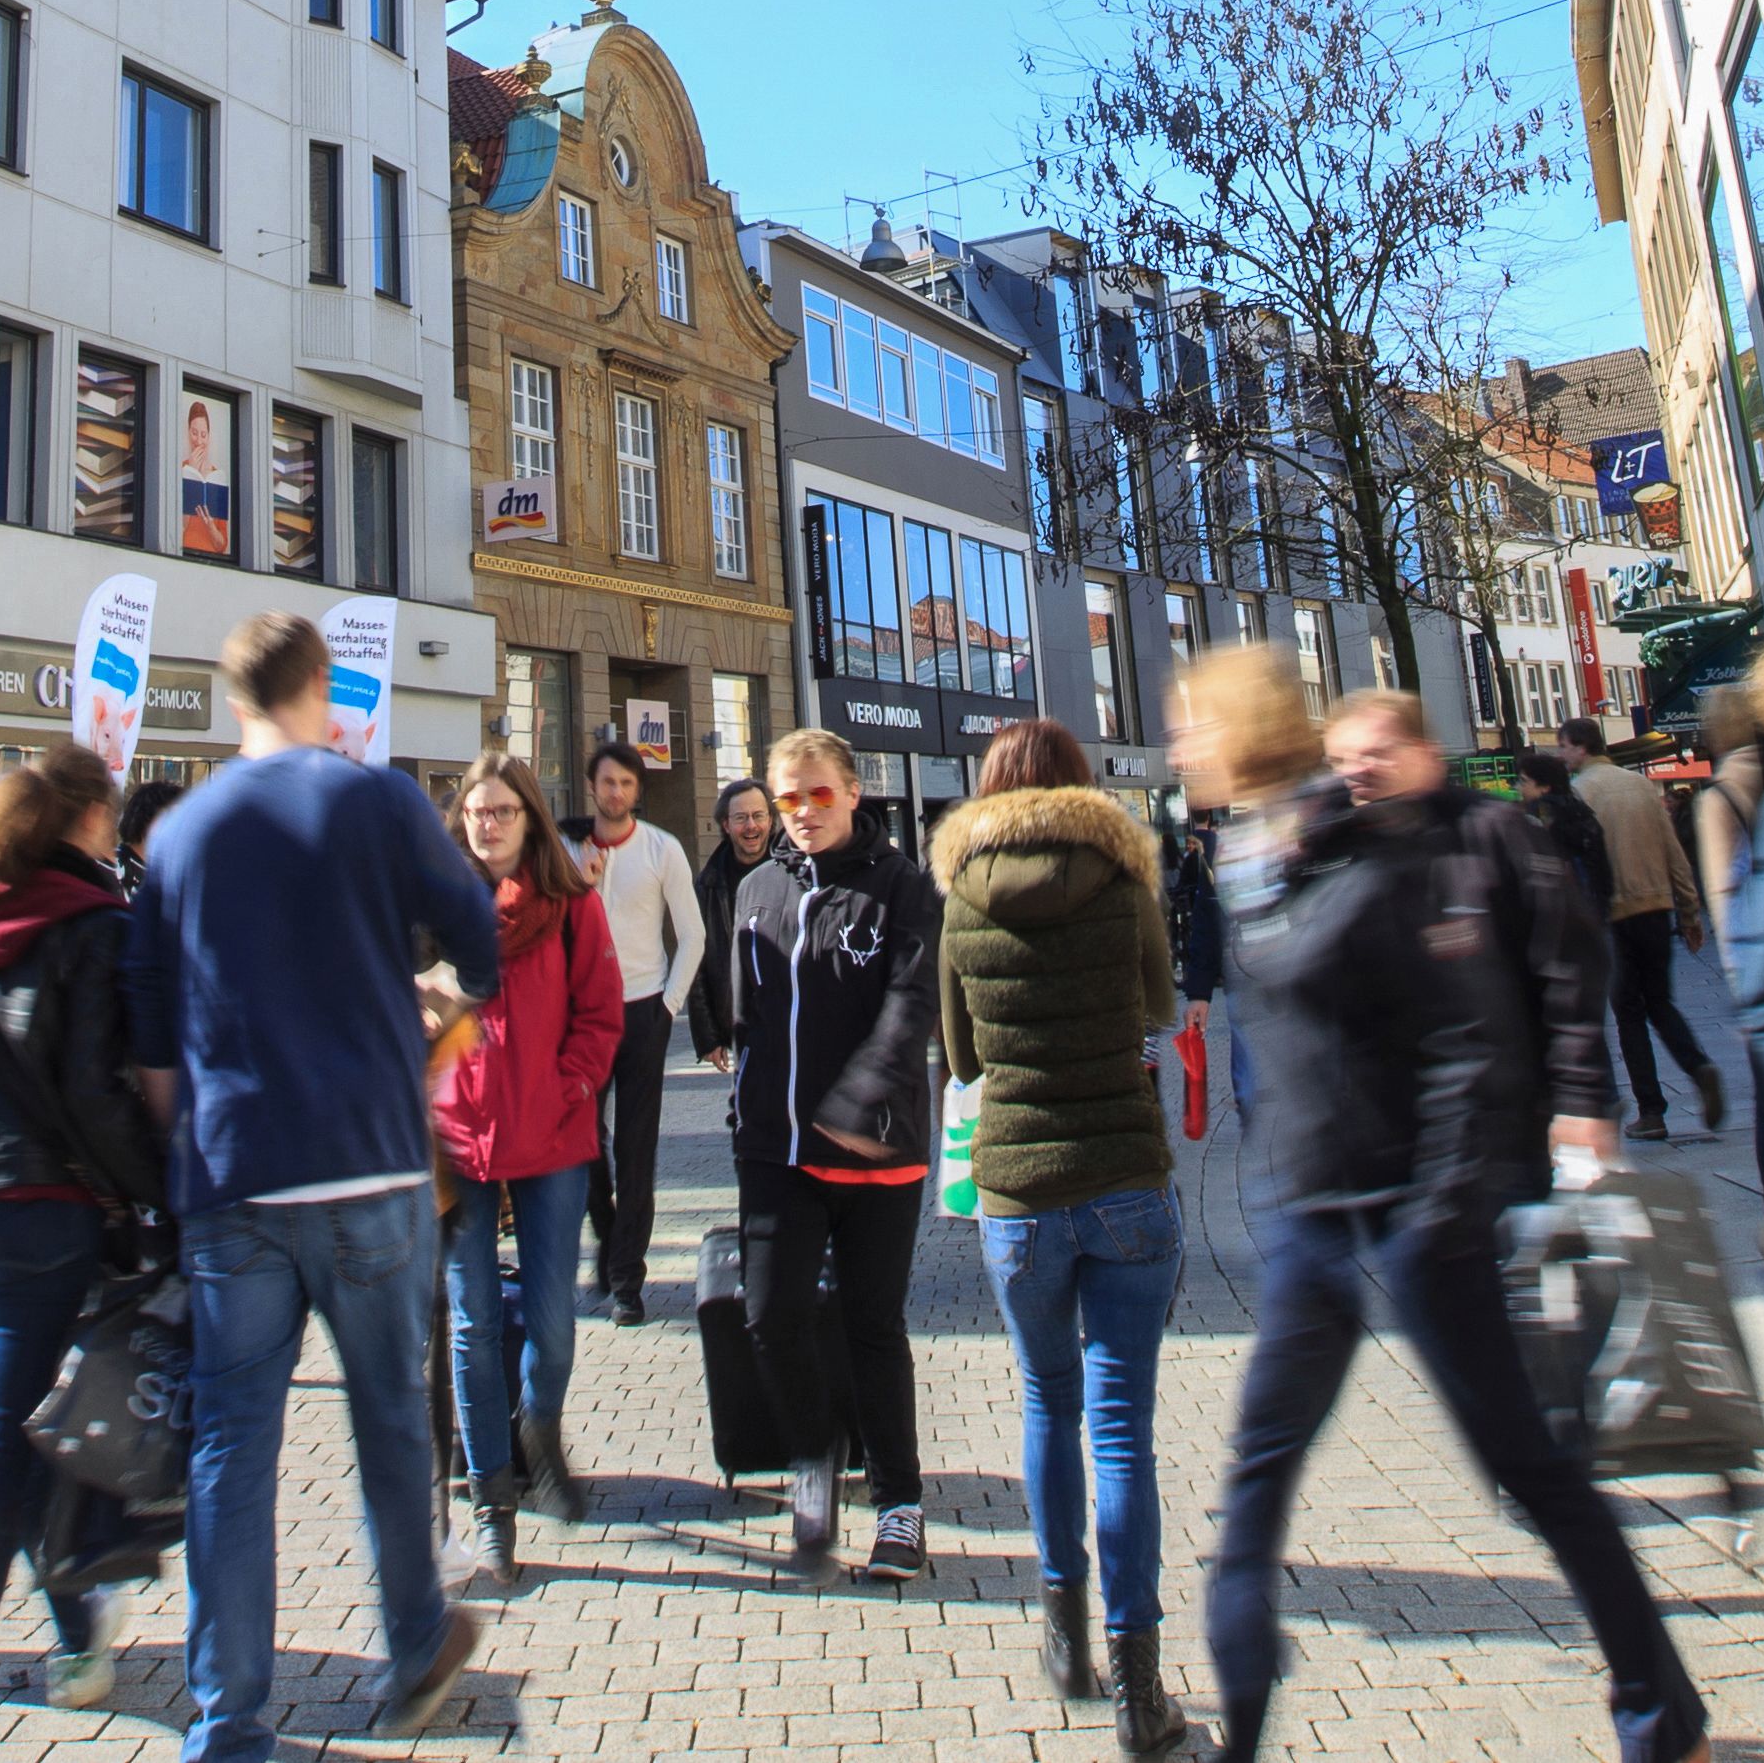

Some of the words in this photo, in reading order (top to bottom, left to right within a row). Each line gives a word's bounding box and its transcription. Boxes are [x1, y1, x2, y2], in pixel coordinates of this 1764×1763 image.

[497, 487, 538, 516] dm
[810, 521, 820, 553] MODA
[813, 554, 822, 581] VERO
[326, 633, 387, 650] tierhaltung
[1580, 610, 1592, 652] vodafone
[330, 647, 387, 660] bschaffen!
[145, 686, 203, 711] CHMUCK
[639, 711, 665, 744] dm
[846, 701, 883, 725] VERO
[884, 706, 922, 729] MODA
[964, 714, 994, 734] JACK
[1113, 757, 1130, 776] CAMP
[1130, 758, 1147, 777] DAVID
